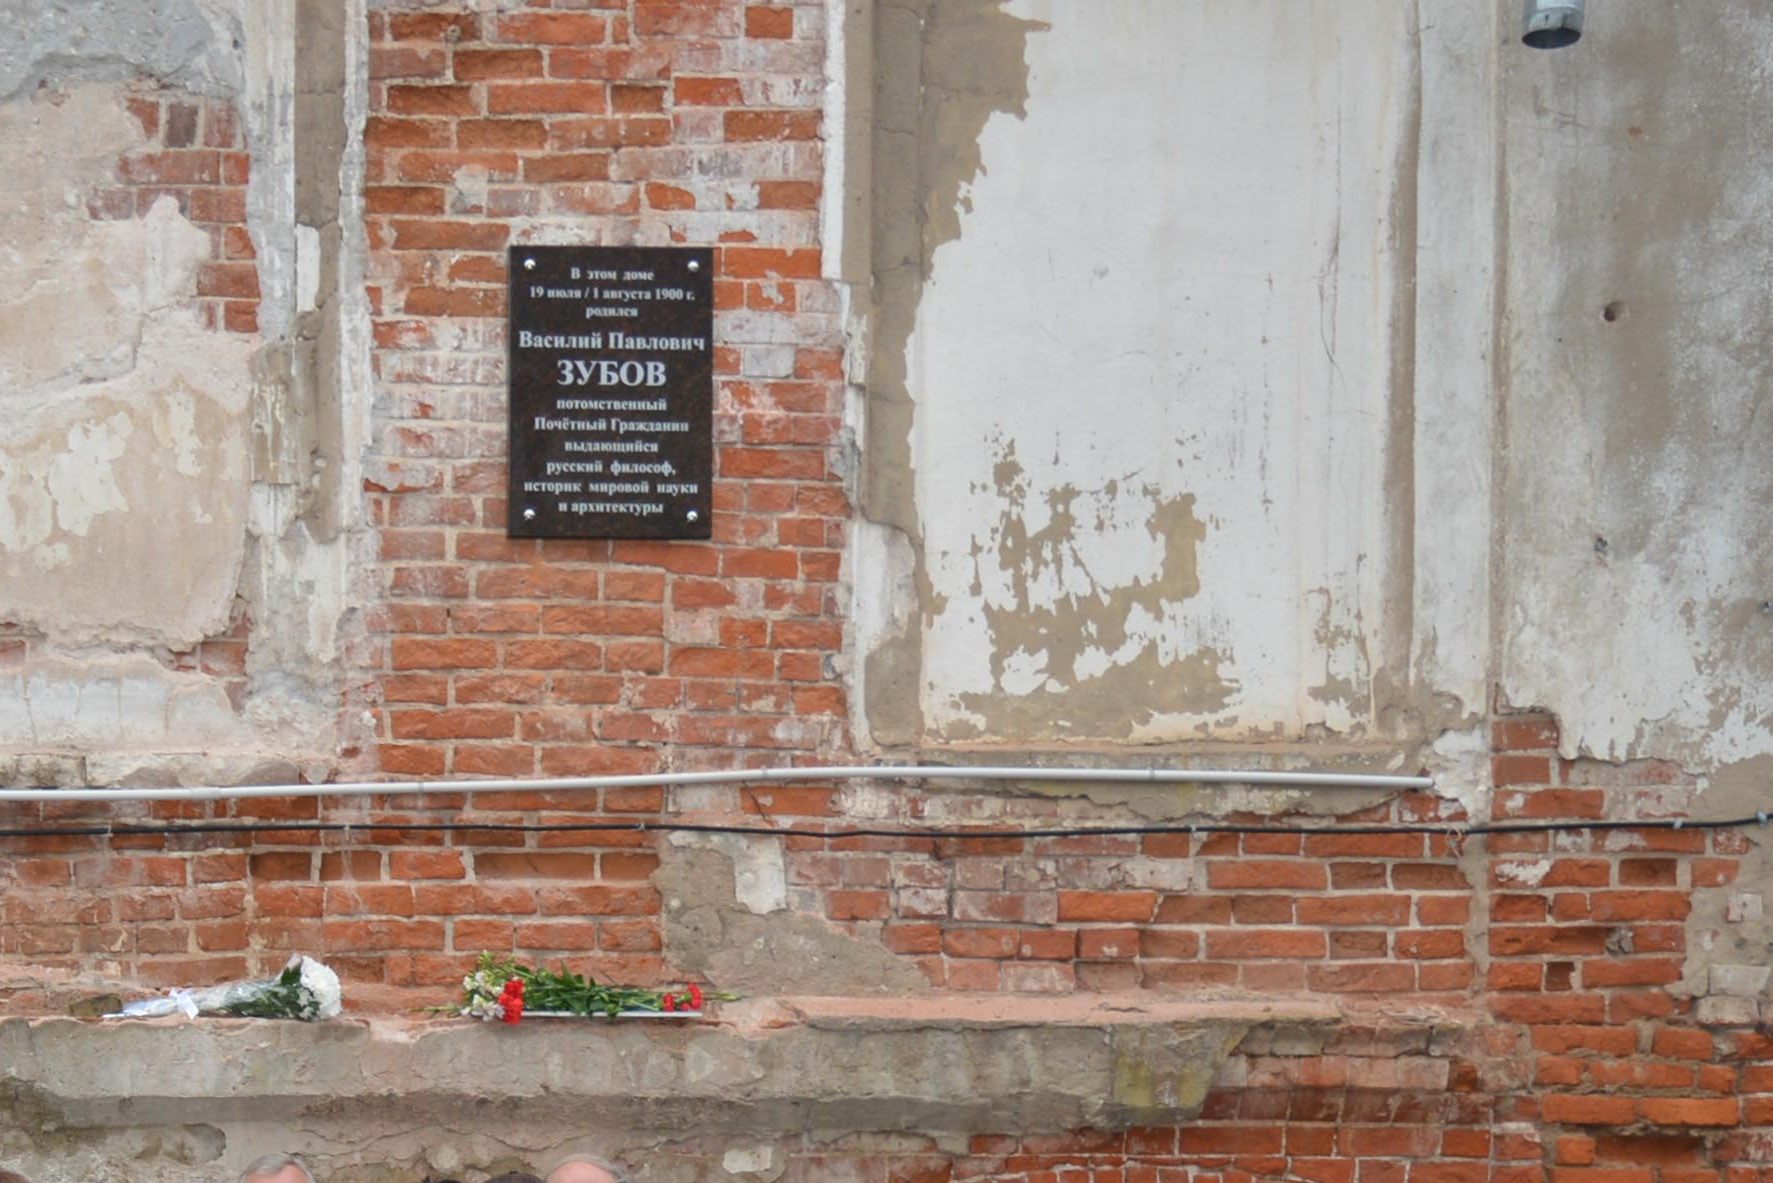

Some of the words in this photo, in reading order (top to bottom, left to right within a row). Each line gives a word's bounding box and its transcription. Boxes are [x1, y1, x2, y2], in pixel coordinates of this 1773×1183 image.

[570, 267, 581, 280] В
[586, 270, 617, 281] этом
[622, 271, 655, 281] доме
[530, 286, 545, 298] 19
[546, 289, 582, 299] июля
[584, 287, 590, 299] /
[593, 287, 599, 299] 1
[602, 289, 652, 302] августа
[655, 287, 684, 300] 1900
[686, 291, 695, 301] г.
[585, 307, 639, 319] родился
[518, 330, 603, 349] Василий
[608, 331, 705, 351] Павлович
[556, 359, 667, 387] ЗУБОВ
[556, 398, 668, 411] потомственный
[534, 416, 607, 431] Почётный
[610, 417, 690, 435] Гражданин
[564, 439, 659, 453] выдающийся
[546, 459, 603, 476] русский
[609, 459, 677, 477] философ,
[523, 480, 582, 496] историк
[588, 480, 650, 497] мировой
[656, 483, 699, 497] науки
[558, 501, 568, 513] и
[570, 502, 664, 517] архитектуры
